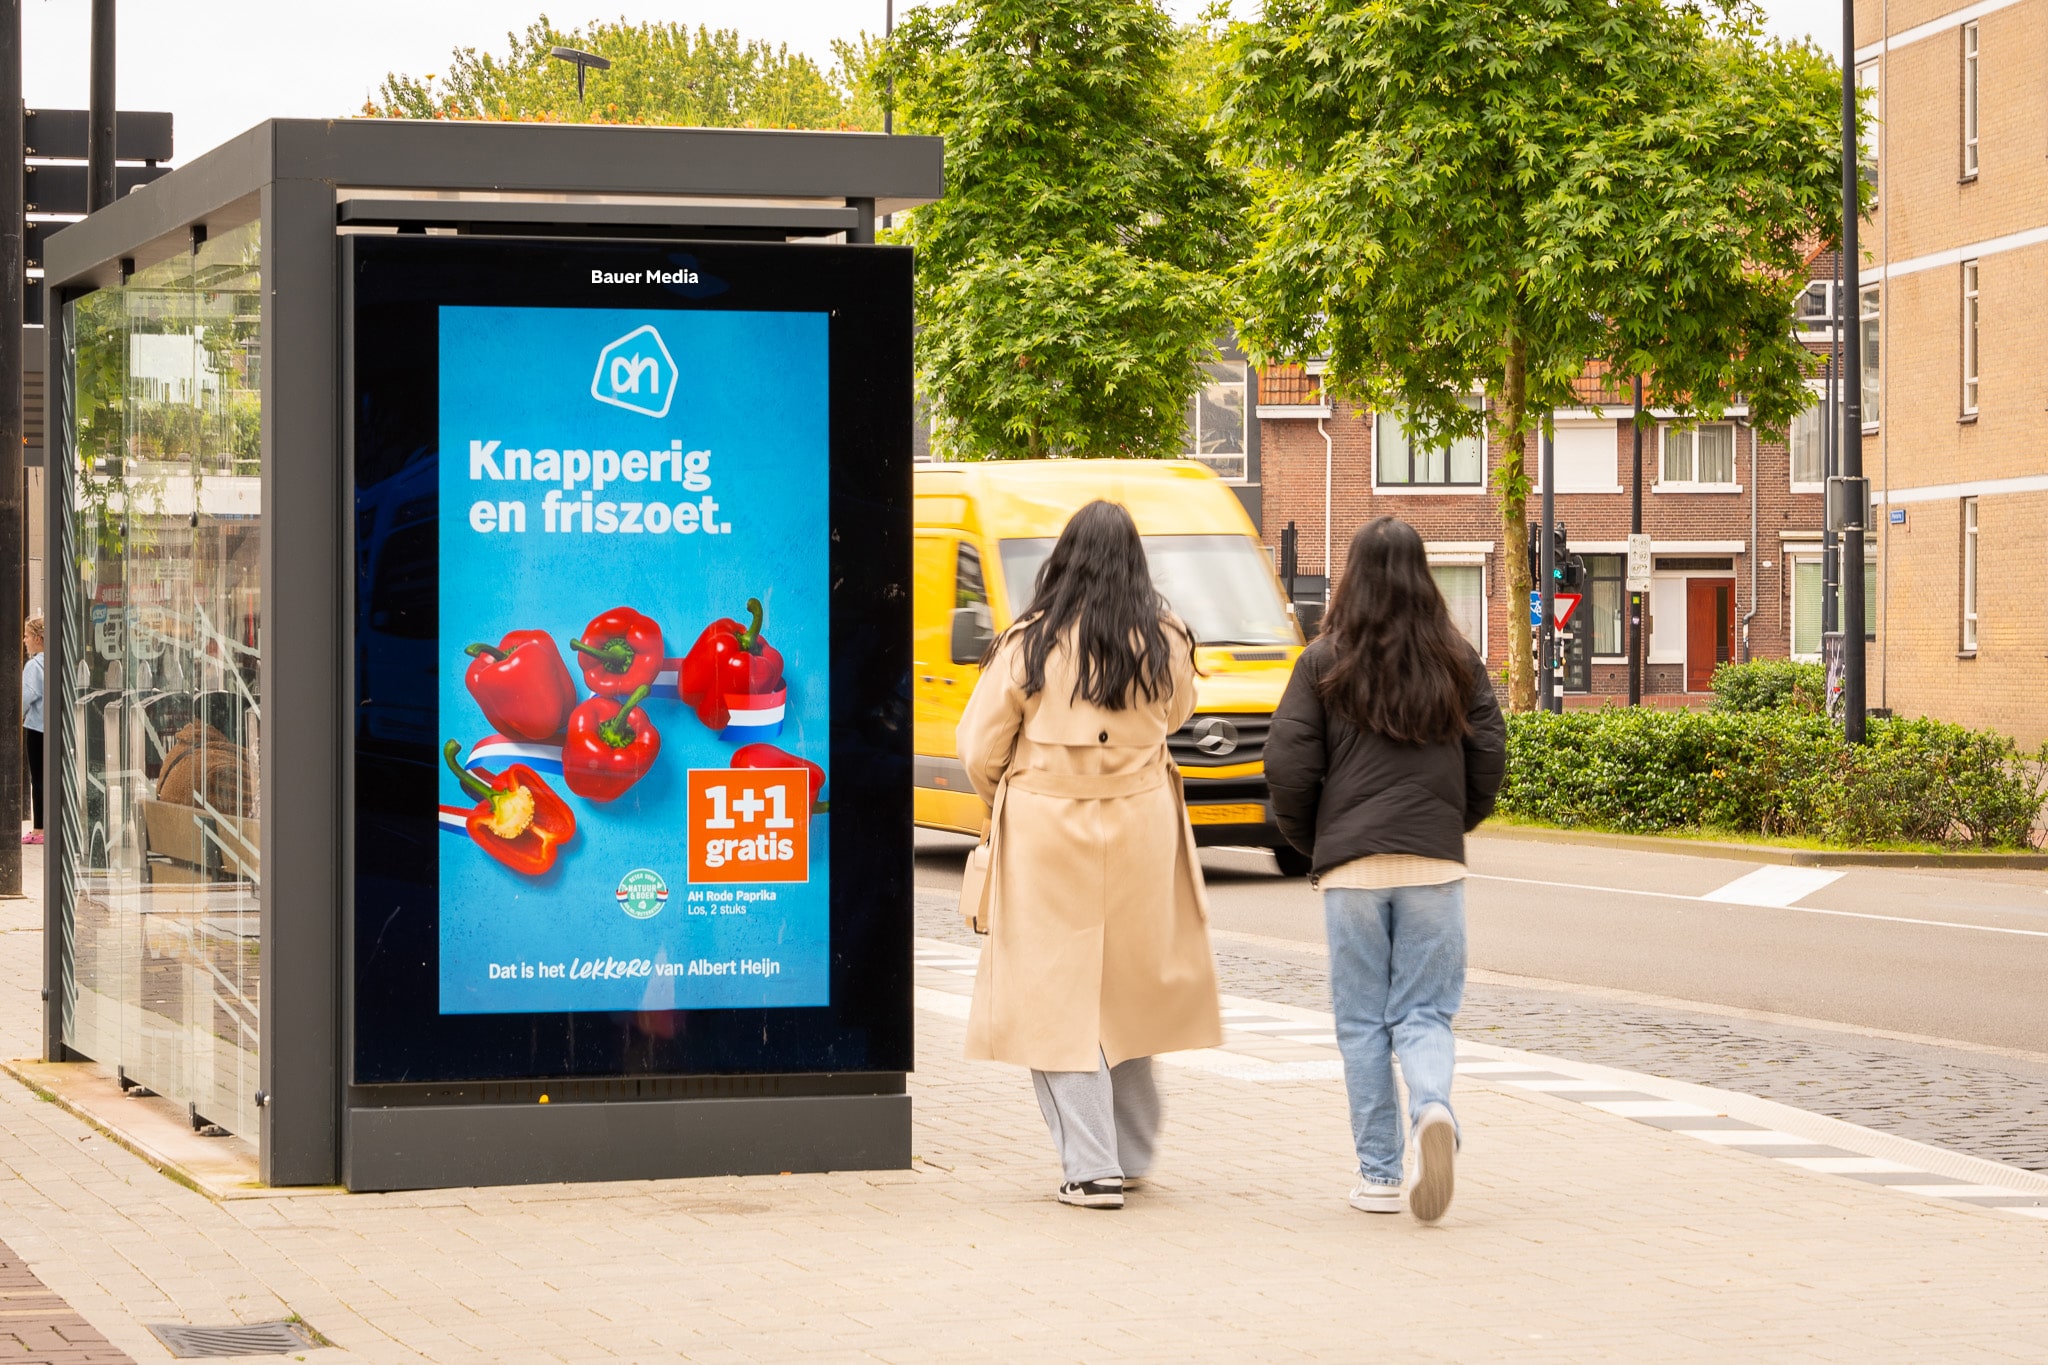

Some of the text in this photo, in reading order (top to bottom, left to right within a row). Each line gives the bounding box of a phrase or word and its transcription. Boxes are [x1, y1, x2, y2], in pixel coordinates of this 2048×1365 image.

[591, 269, 699, 284] Bauer Media
[469, 440, 712, 492] Knapperig
[469, 490, 732, 535] en friszoet.
[704, 784, 794, 829] 1+1
[705, 832, 794, 867] gratis
[628, 884, 657, 892] NATUUR
[687, 889, 777, 903] AH Rode Paprika
[687, 903, 747, 916] Los, 2 stuks
[488, 963, 517, 979] Dat
[521, 962, 534, 979] is
[538, 961, 566, 978] het
[655, 963, 684, 976] van
[687, 959, 737, 976] Albert
[740, 958, 780, 978] Heijn
